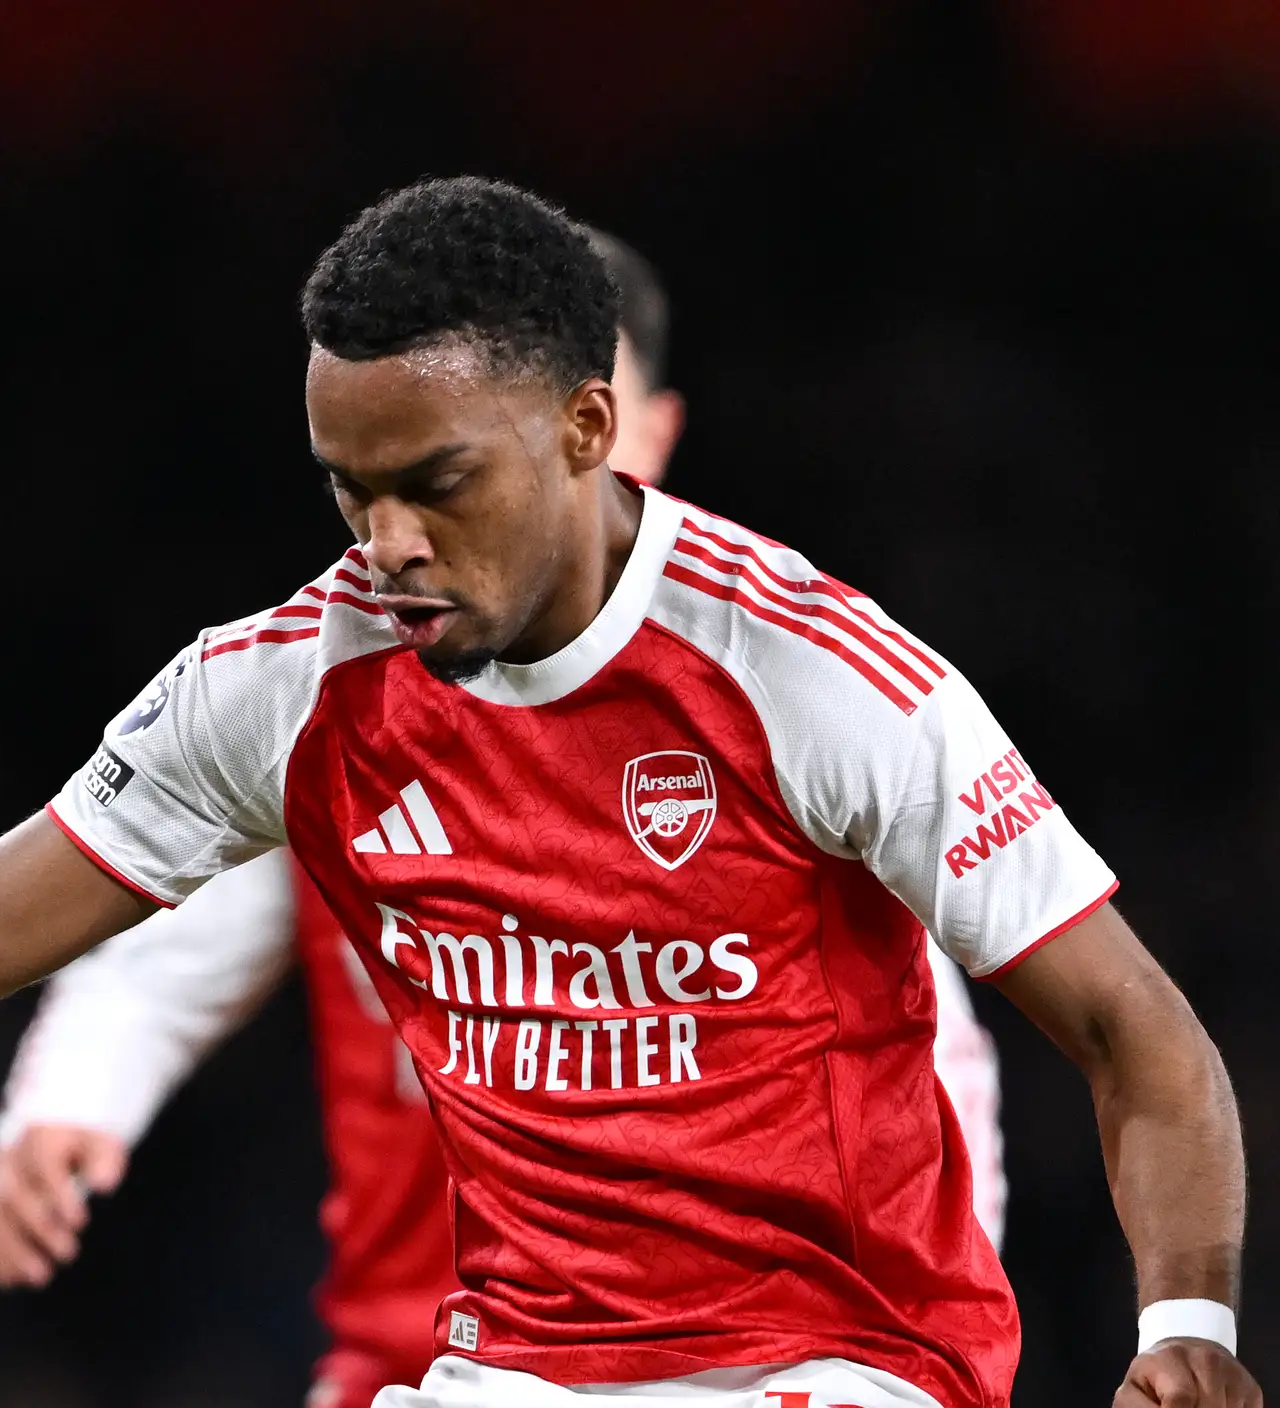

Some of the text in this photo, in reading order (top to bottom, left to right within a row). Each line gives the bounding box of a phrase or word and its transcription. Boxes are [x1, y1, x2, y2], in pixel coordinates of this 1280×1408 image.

[637, 770, 704, 792] Arsenal
[375, 902, 759, 1010] Emirates
[438, 1010, 501, 1088] FLY
[514, 1013, 702, 1092] BETTER
